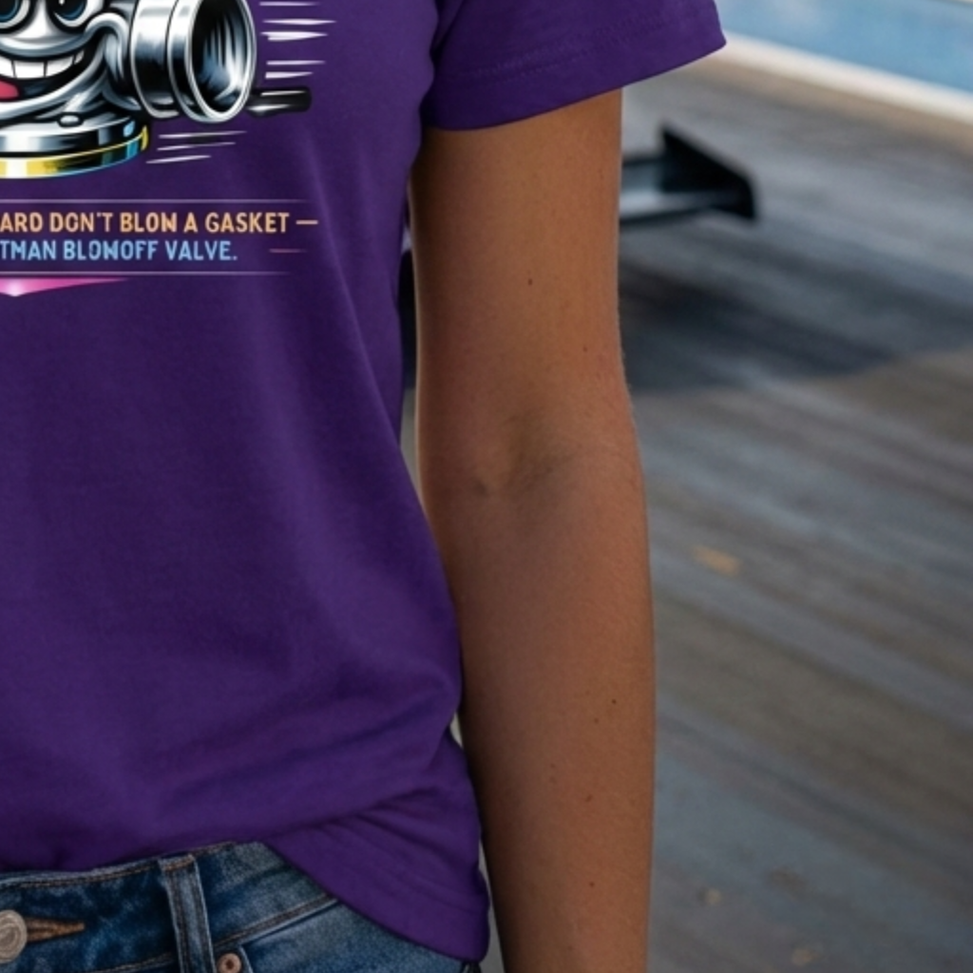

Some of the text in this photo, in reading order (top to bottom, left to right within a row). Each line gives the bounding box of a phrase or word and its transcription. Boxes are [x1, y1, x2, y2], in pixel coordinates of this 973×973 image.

[183, 212, 198, 233] A
[205, 212, 290, 233] GASKET
[165, 240, 237, 261] VALVE.
